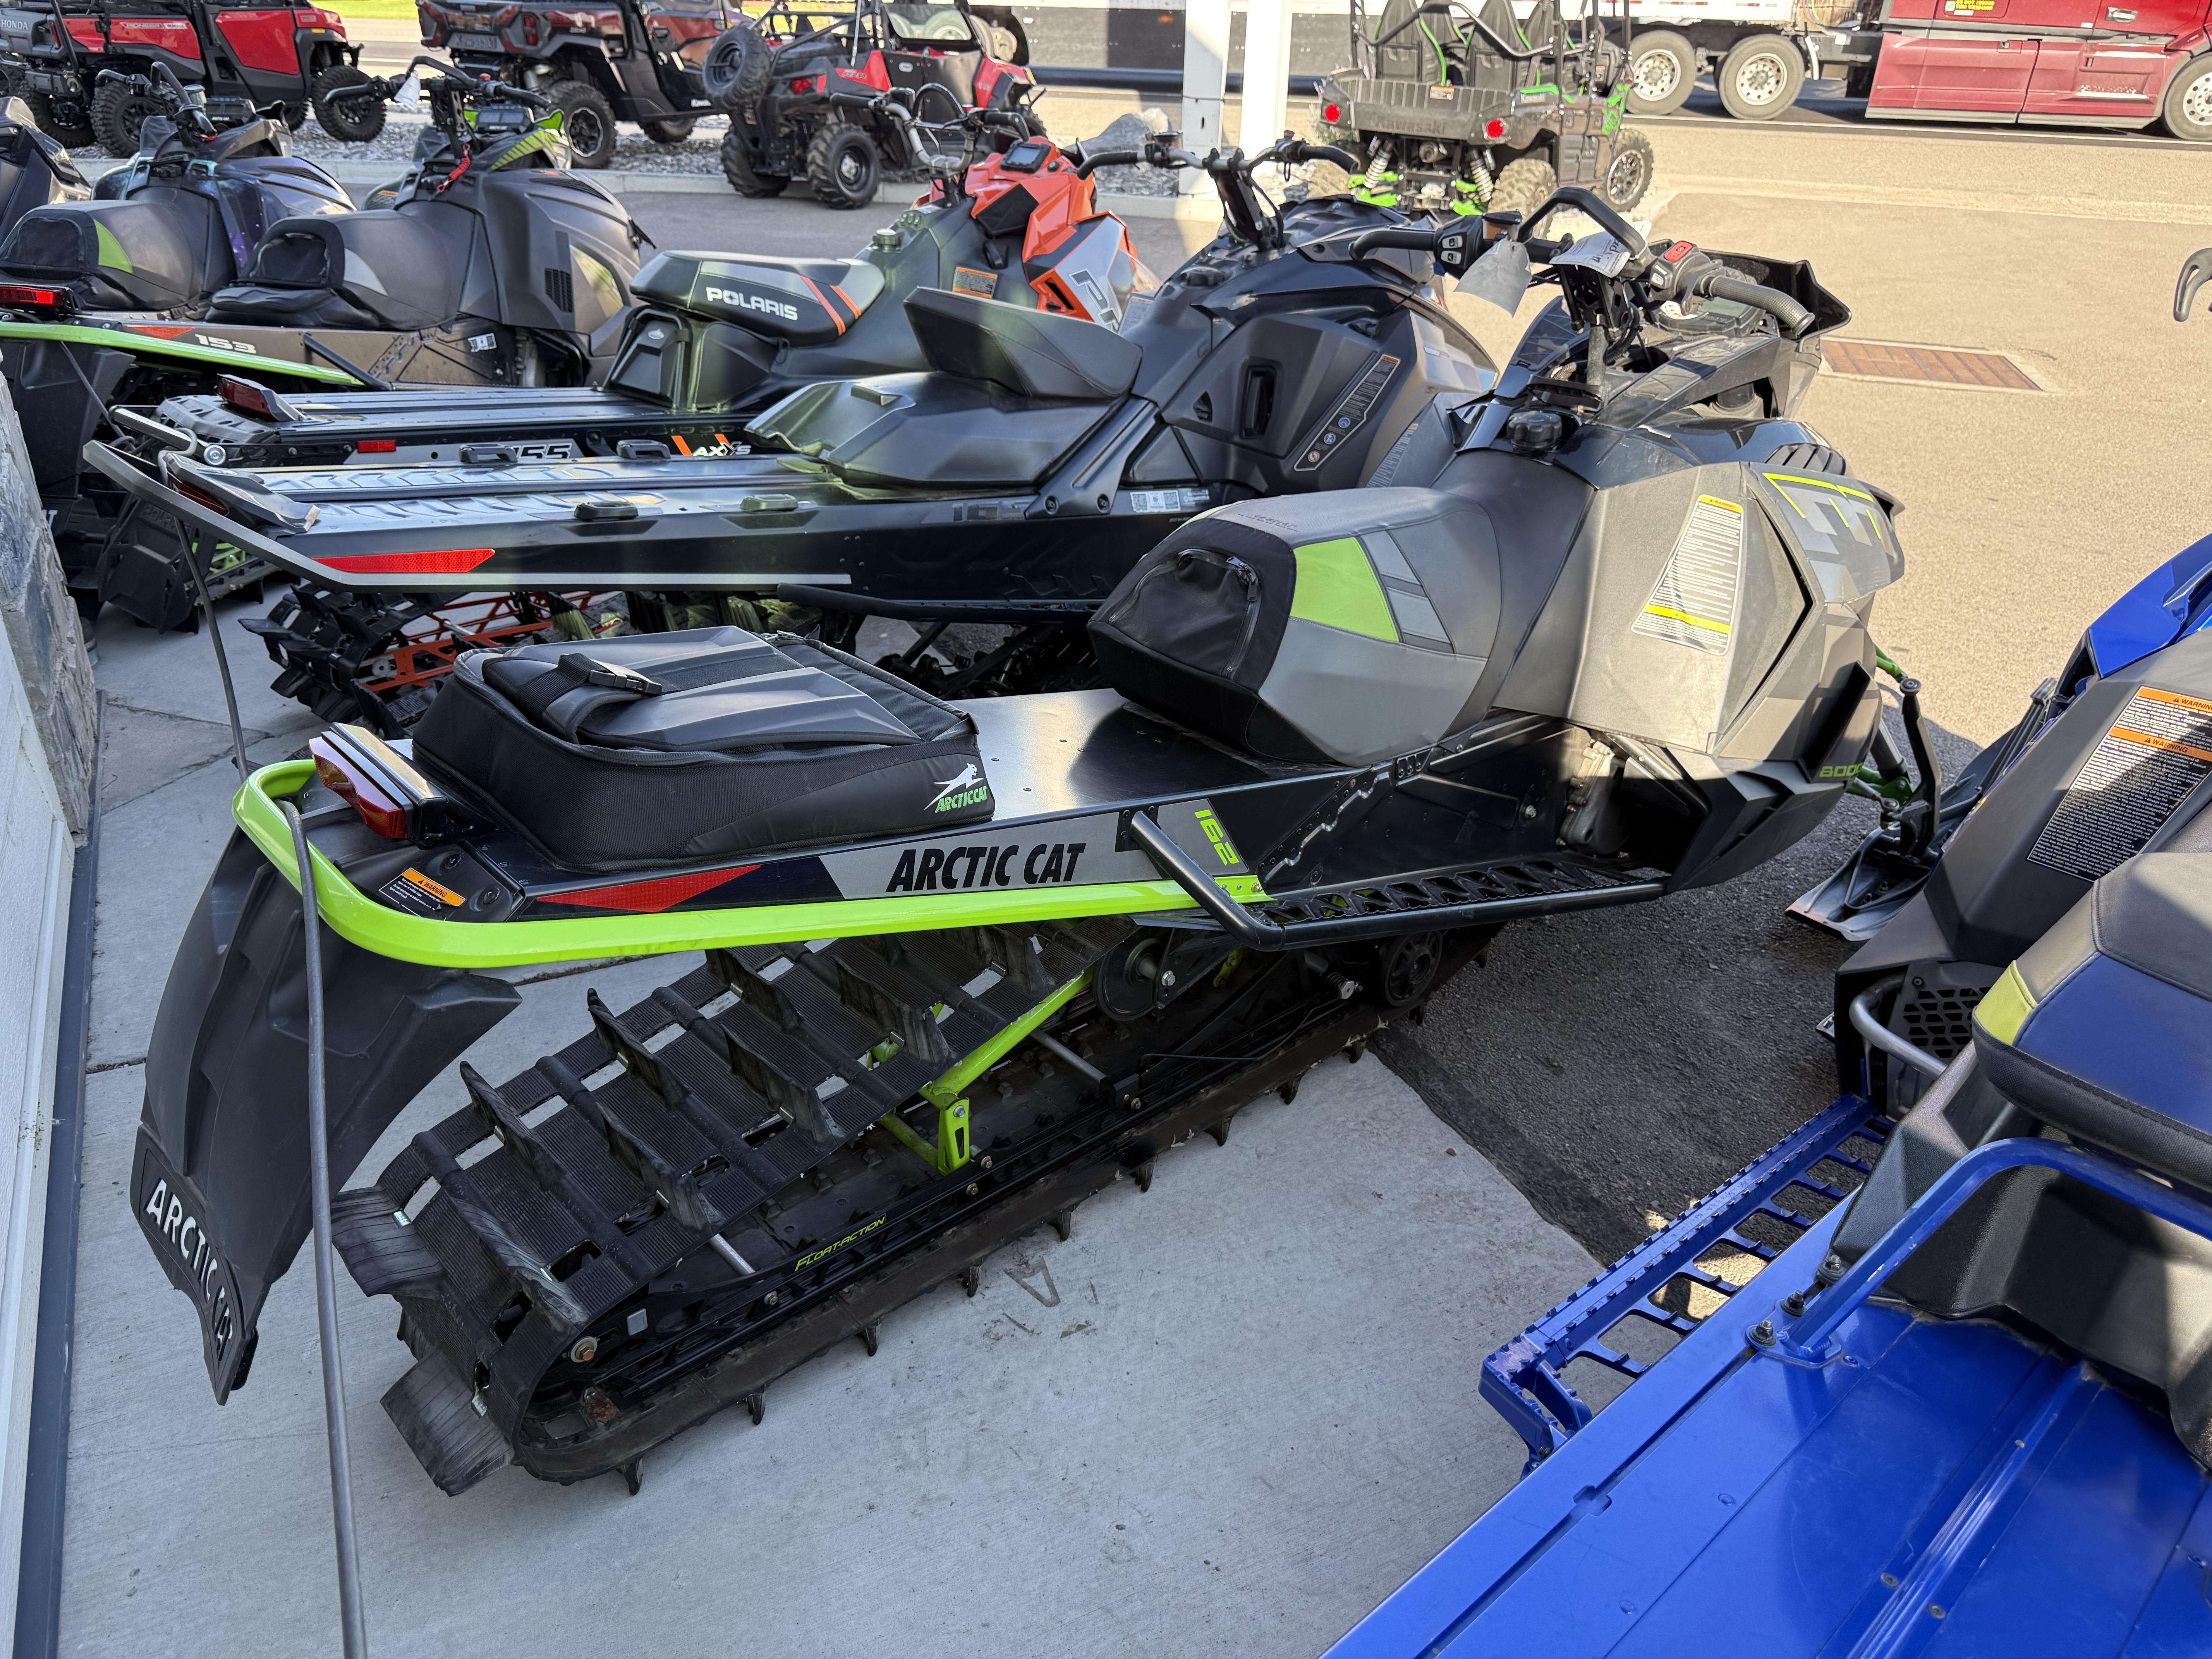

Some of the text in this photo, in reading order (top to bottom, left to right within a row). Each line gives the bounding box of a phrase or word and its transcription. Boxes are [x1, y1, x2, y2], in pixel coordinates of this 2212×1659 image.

[1, 19, 29, 30] HONDA
[706, 287, 798, 321] POLARIS
[195, 334, 256, 354] 153
[2181, 699, 2212, 710] WARNIN
[2153, 738, 2188, 753] WARNING
[1194, 809, 1240, 866] 162
[885, 843, 1086, 893] ARCTIC CAT
[423, 881, 448, 898] WARNING
[144, 1176, 218, 1301] ARCTIC
